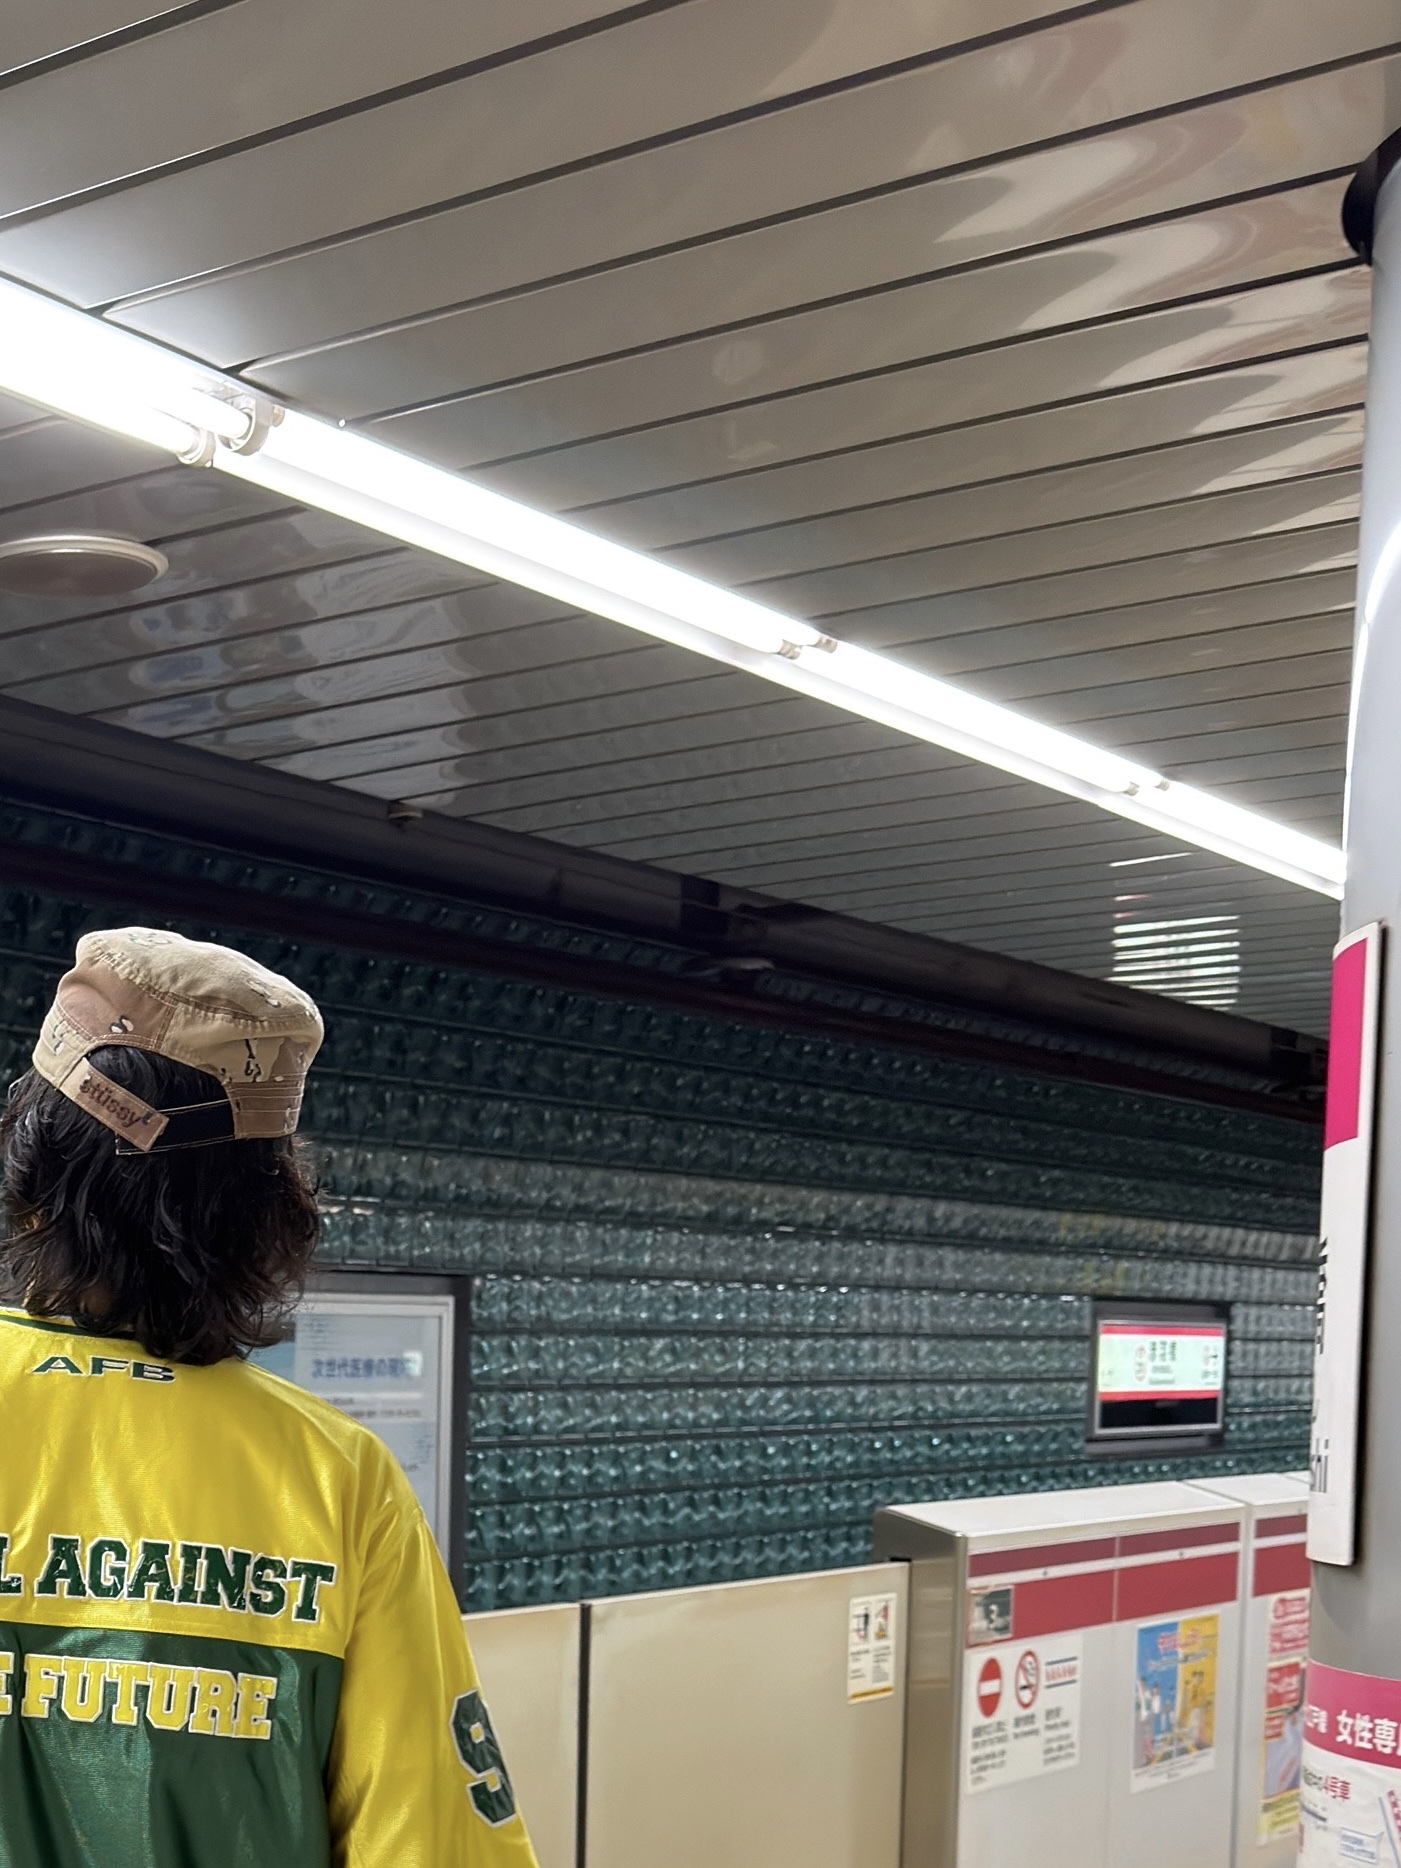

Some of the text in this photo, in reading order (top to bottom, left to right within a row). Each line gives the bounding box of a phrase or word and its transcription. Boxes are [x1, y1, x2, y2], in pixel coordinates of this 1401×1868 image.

[30, 1354, 176, 1384] AFB
[34, 1534, 336, 1623] AGAINST
[21, 1653, 278, 1740] FUTURE
[1336, 1709, 1401, 1757] 女性専
[449, 1688, 517, 1828] 9
